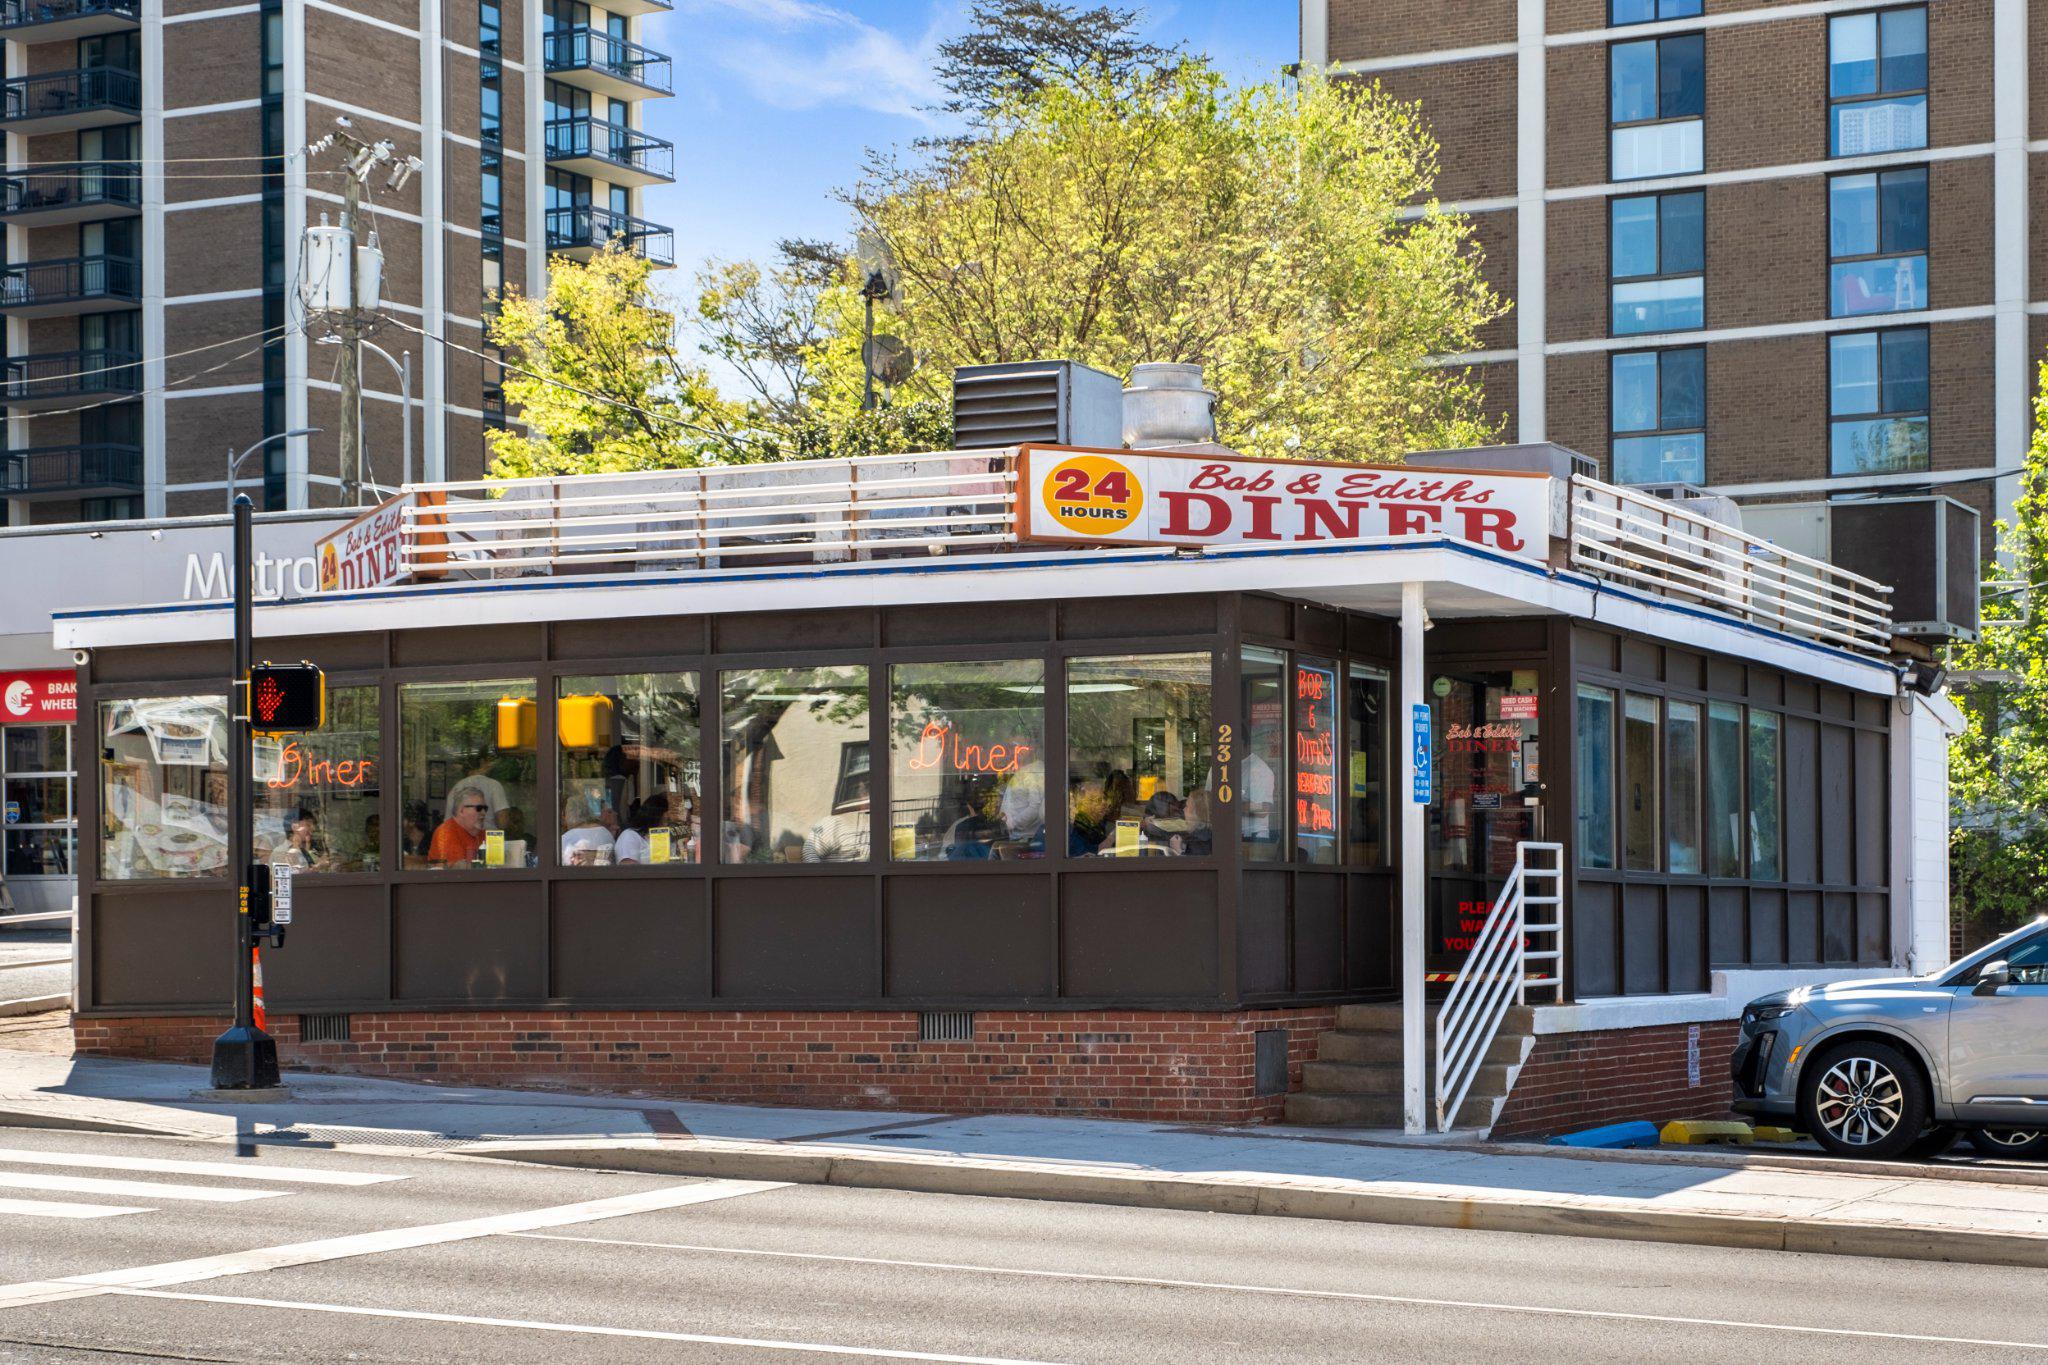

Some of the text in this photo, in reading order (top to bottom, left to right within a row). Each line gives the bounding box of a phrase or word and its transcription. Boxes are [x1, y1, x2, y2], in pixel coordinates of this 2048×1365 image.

[1054, 468, 1131, 504] 24
[1285, 473, 1322, 495] &
[1334, 473, 1496, 504] Ediths
[1059, 505, 1129, 520] HOURS
[1158, 490, 1525, 552] DINER
[183, 551, 317, 600] Mtro
[322, 552, 337, 584] 24
[1297, 669, 1323, 700] BOB
[1501, 696, 1517, 705] NEED
[1517, 696, 1533, 704] CASH
[909, 721, 1030, 772] Diner
[1447, 739, 1520, 753] DINER
[267, 742, 372, 788] Diner
[1216, 724, 1233, 803] 2310
[1444, 937, 1485, 950] YOU
